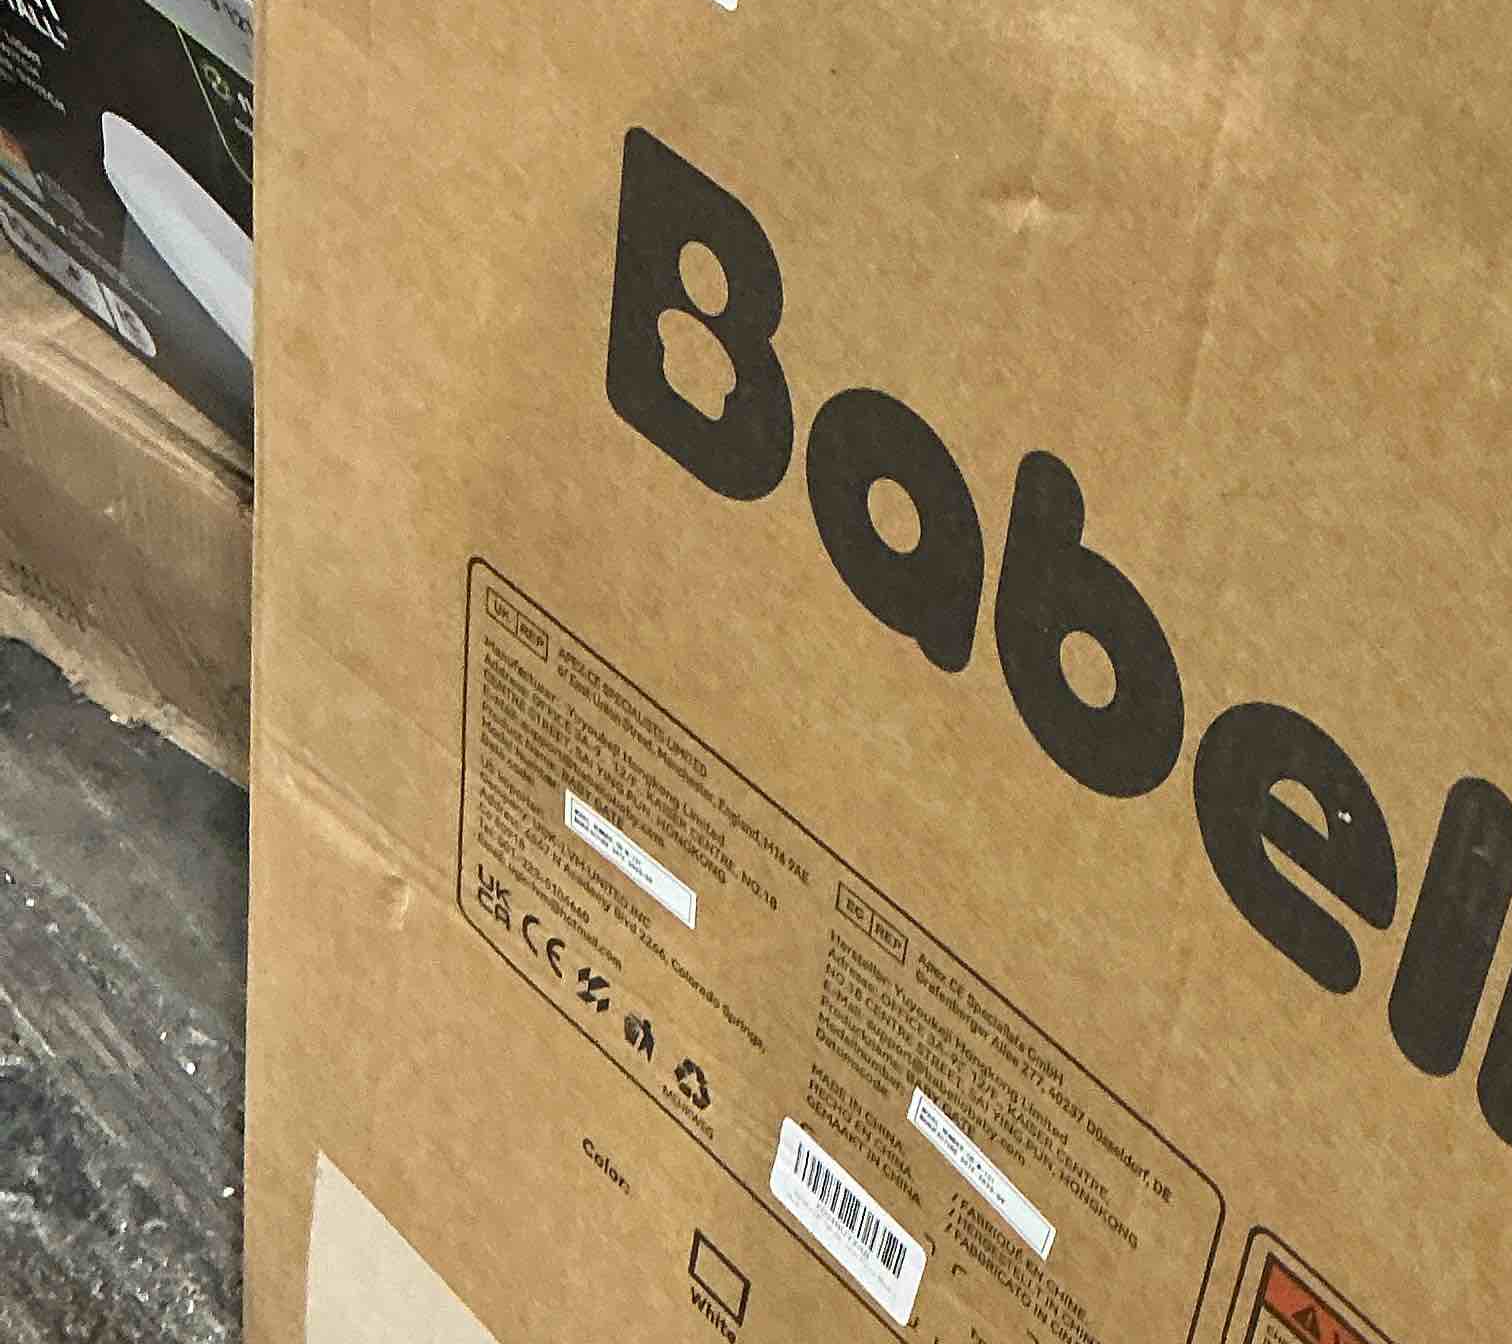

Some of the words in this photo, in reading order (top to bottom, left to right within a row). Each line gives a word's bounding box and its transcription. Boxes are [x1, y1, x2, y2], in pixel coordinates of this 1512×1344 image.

[519, 618, 545, 654] REP
[656, 815, 726, 887] HONGKONG
[845, 896, 865, 924] EC
[874, 920, 903, 957] REP
[670, 956, 720, 1013] Colorado
[1026, 1044, 1064, 1088] GmbH
[1020, 1095, 1069, 1148] Limited
[1057, 1169, 1138, 1250] HONGKONG
[1151, 1176, 1172, 1205] DE
[690, 1284, 738, 1344] White
